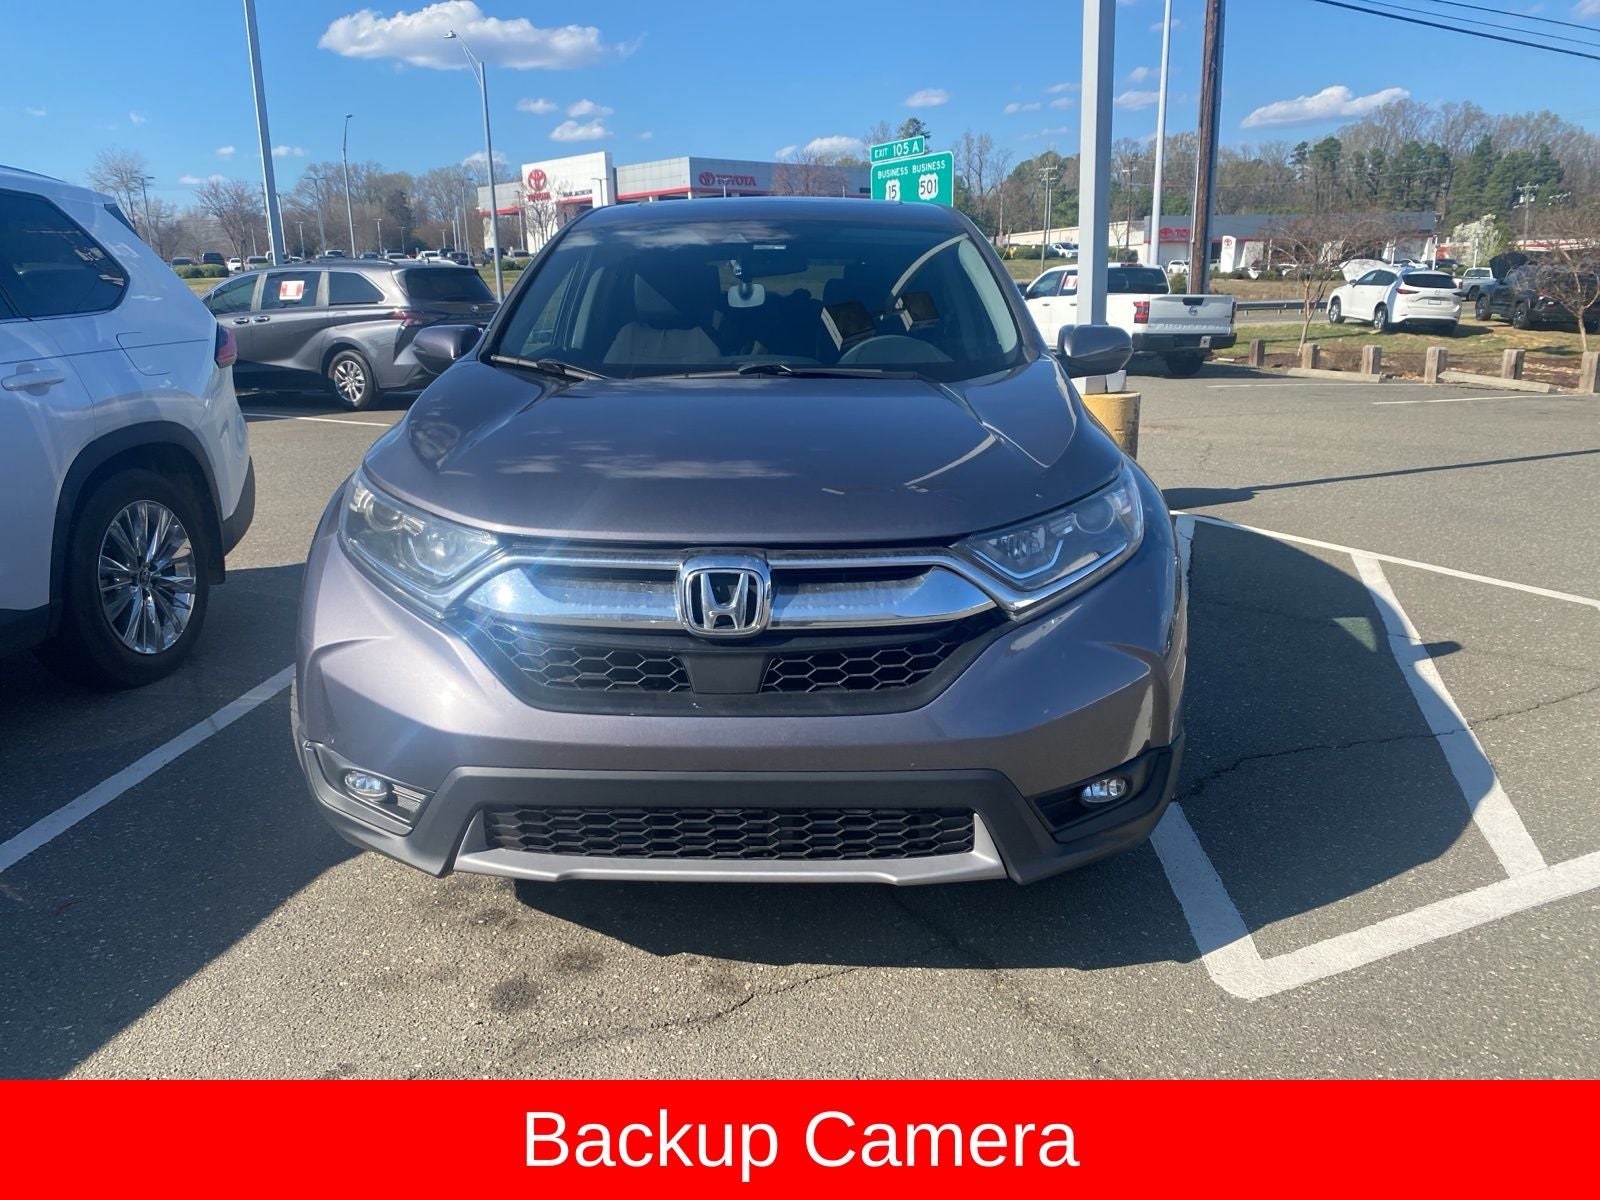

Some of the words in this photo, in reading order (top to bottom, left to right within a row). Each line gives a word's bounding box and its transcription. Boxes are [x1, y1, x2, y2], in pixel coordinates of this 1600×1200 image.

[874, 148, 888, 158] EXIT
[893, 143, 909, 157] 105
[912, 141, 920, 153] A
[878, 167, 908, 179] BUSINESS
[912, 160, 945, 173] BUSINESS
[715, 174, 757, 186] TOYOTA
[920, 179, 937, 195] 501
[888, 184, 897, 199] 15
